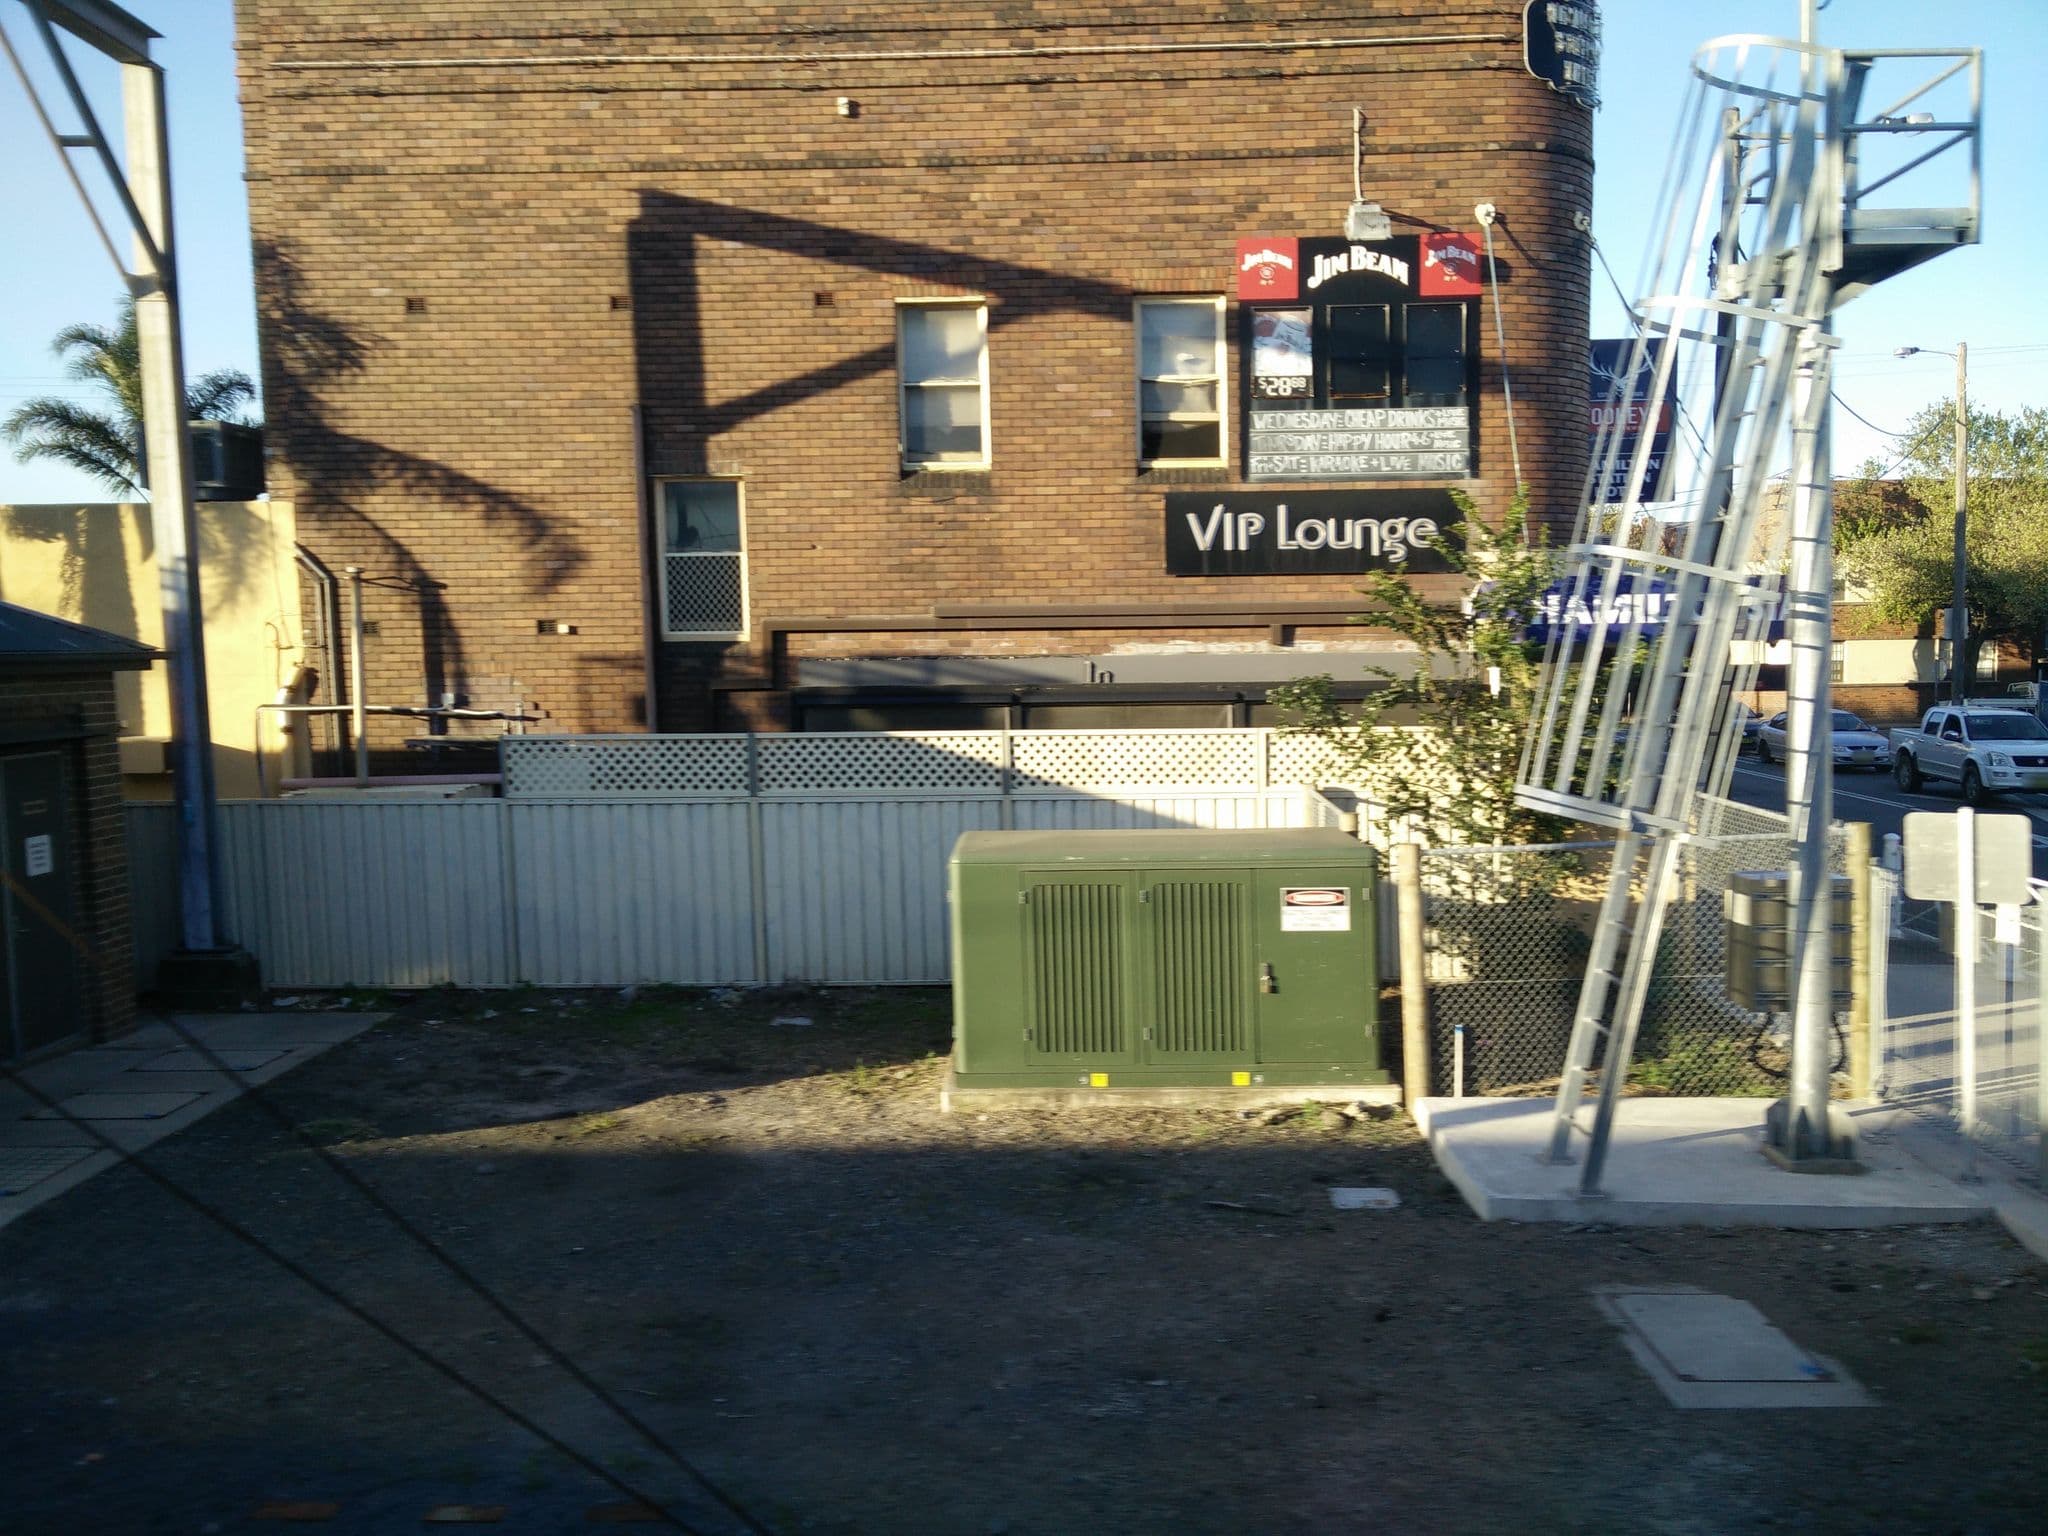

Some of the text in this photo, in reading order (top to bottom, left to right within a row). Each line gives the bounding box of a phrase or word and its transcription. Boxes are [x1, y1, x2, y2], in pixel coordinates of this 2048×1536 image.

[1307, 245, 1409, 289] JIM BEAM
[1186, 503, 1439, 563] VIP Lounge
